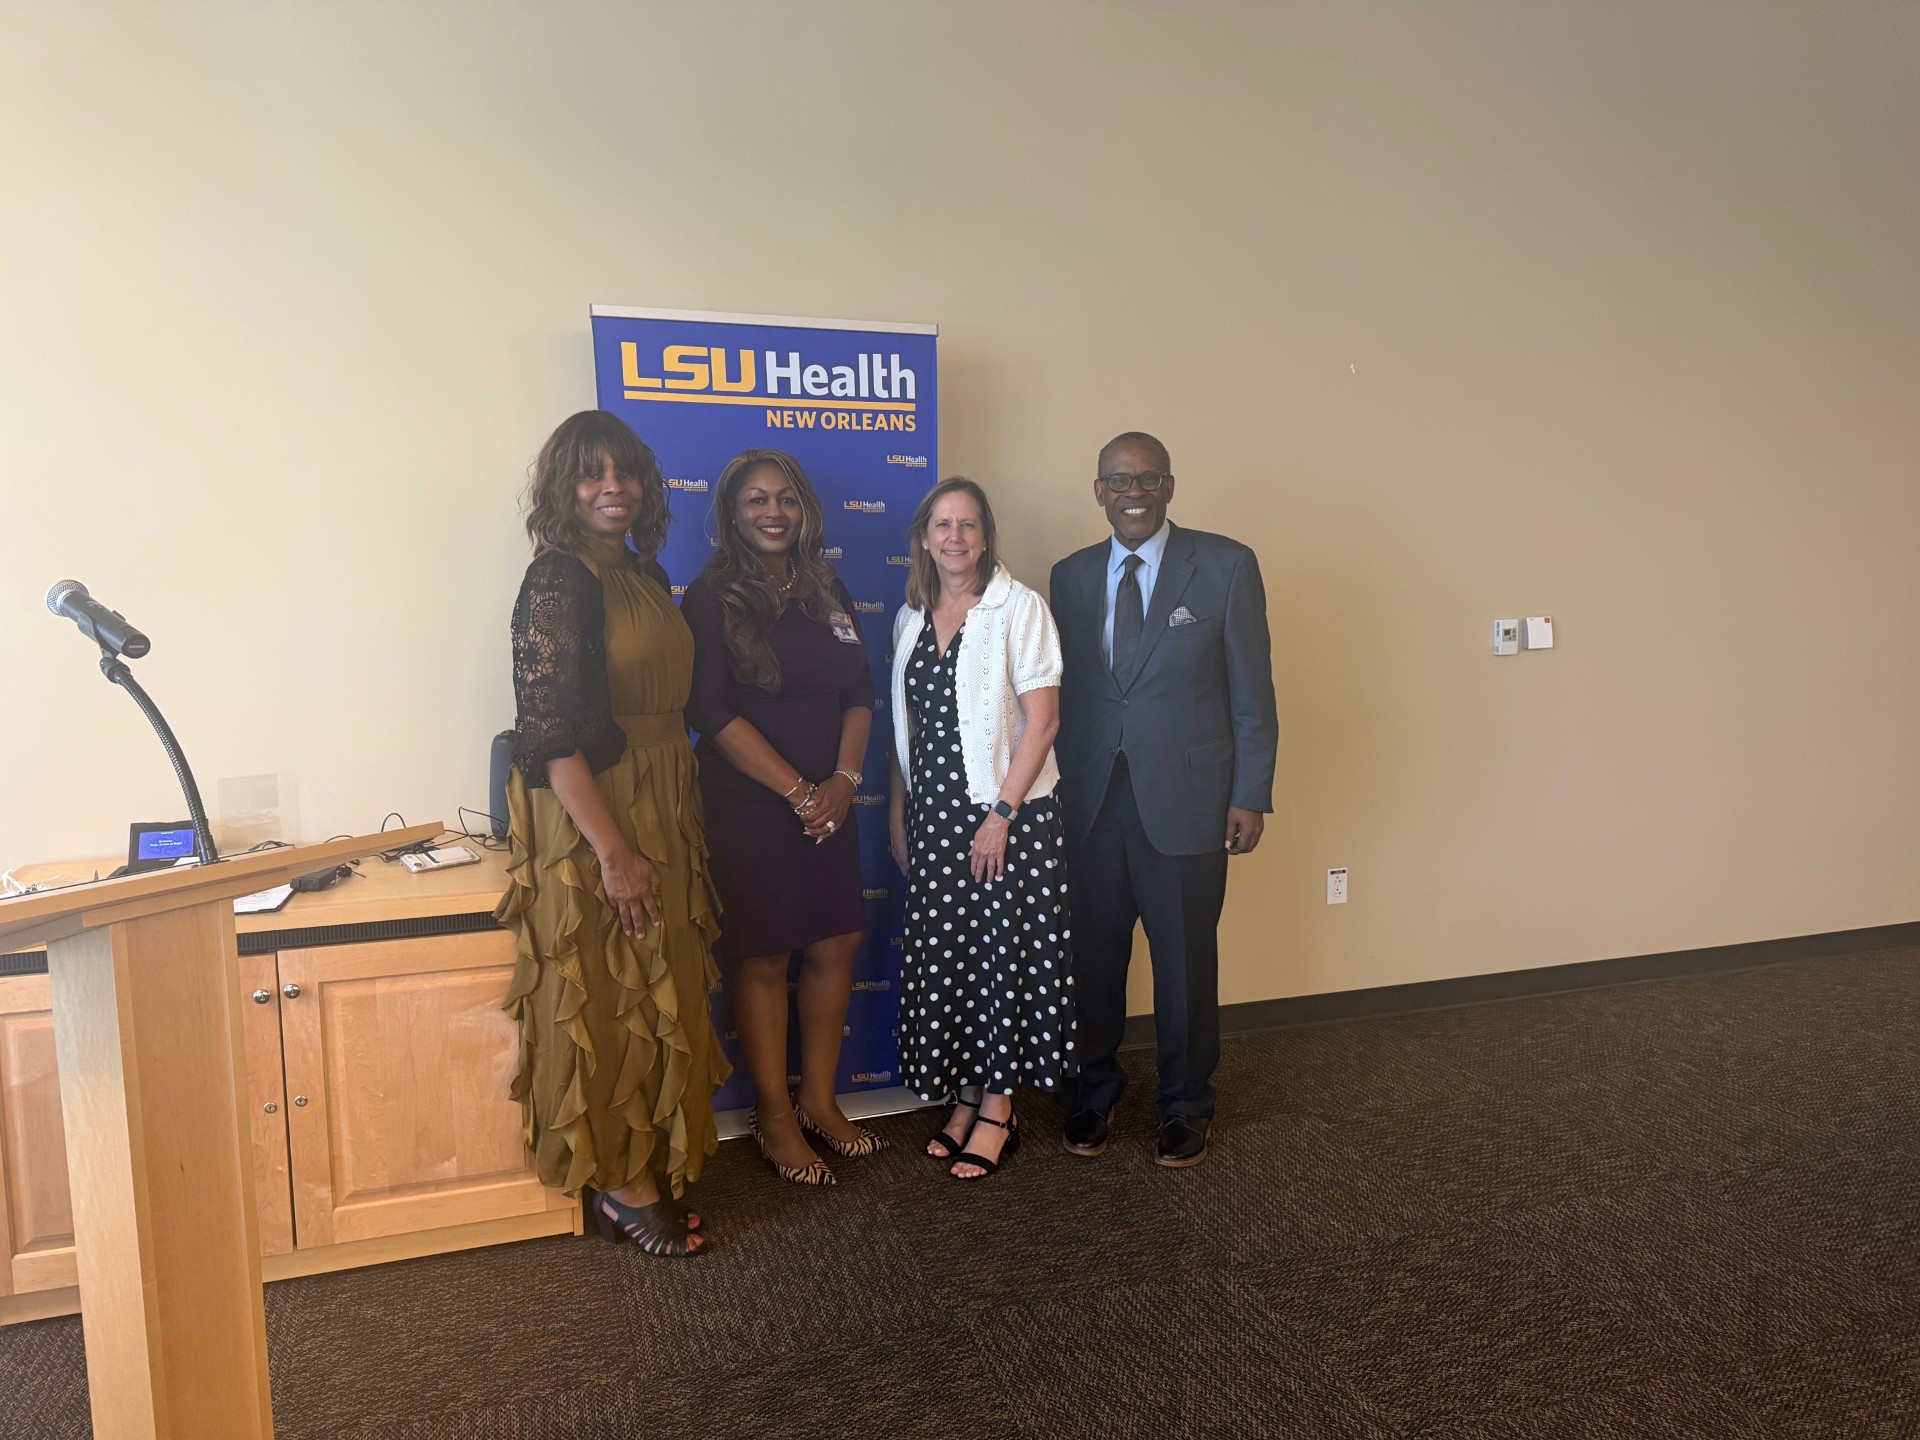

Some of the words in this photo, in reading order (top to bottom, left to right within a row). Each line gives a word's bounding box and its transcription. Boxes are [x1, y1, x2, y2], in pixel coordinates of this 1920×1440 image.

[621, 342, 756, 393] LSU
[765, 351, 916, 399] Health
[766, 410, 817, 429] NEW
[821, 412, 916, 432] ORLEANS
[905, 455, 927, 463] Health
[683, 479, 708, 487] Health
[869, 979, 891, 988] Health
[870, 1070, 891, 1080] Health
